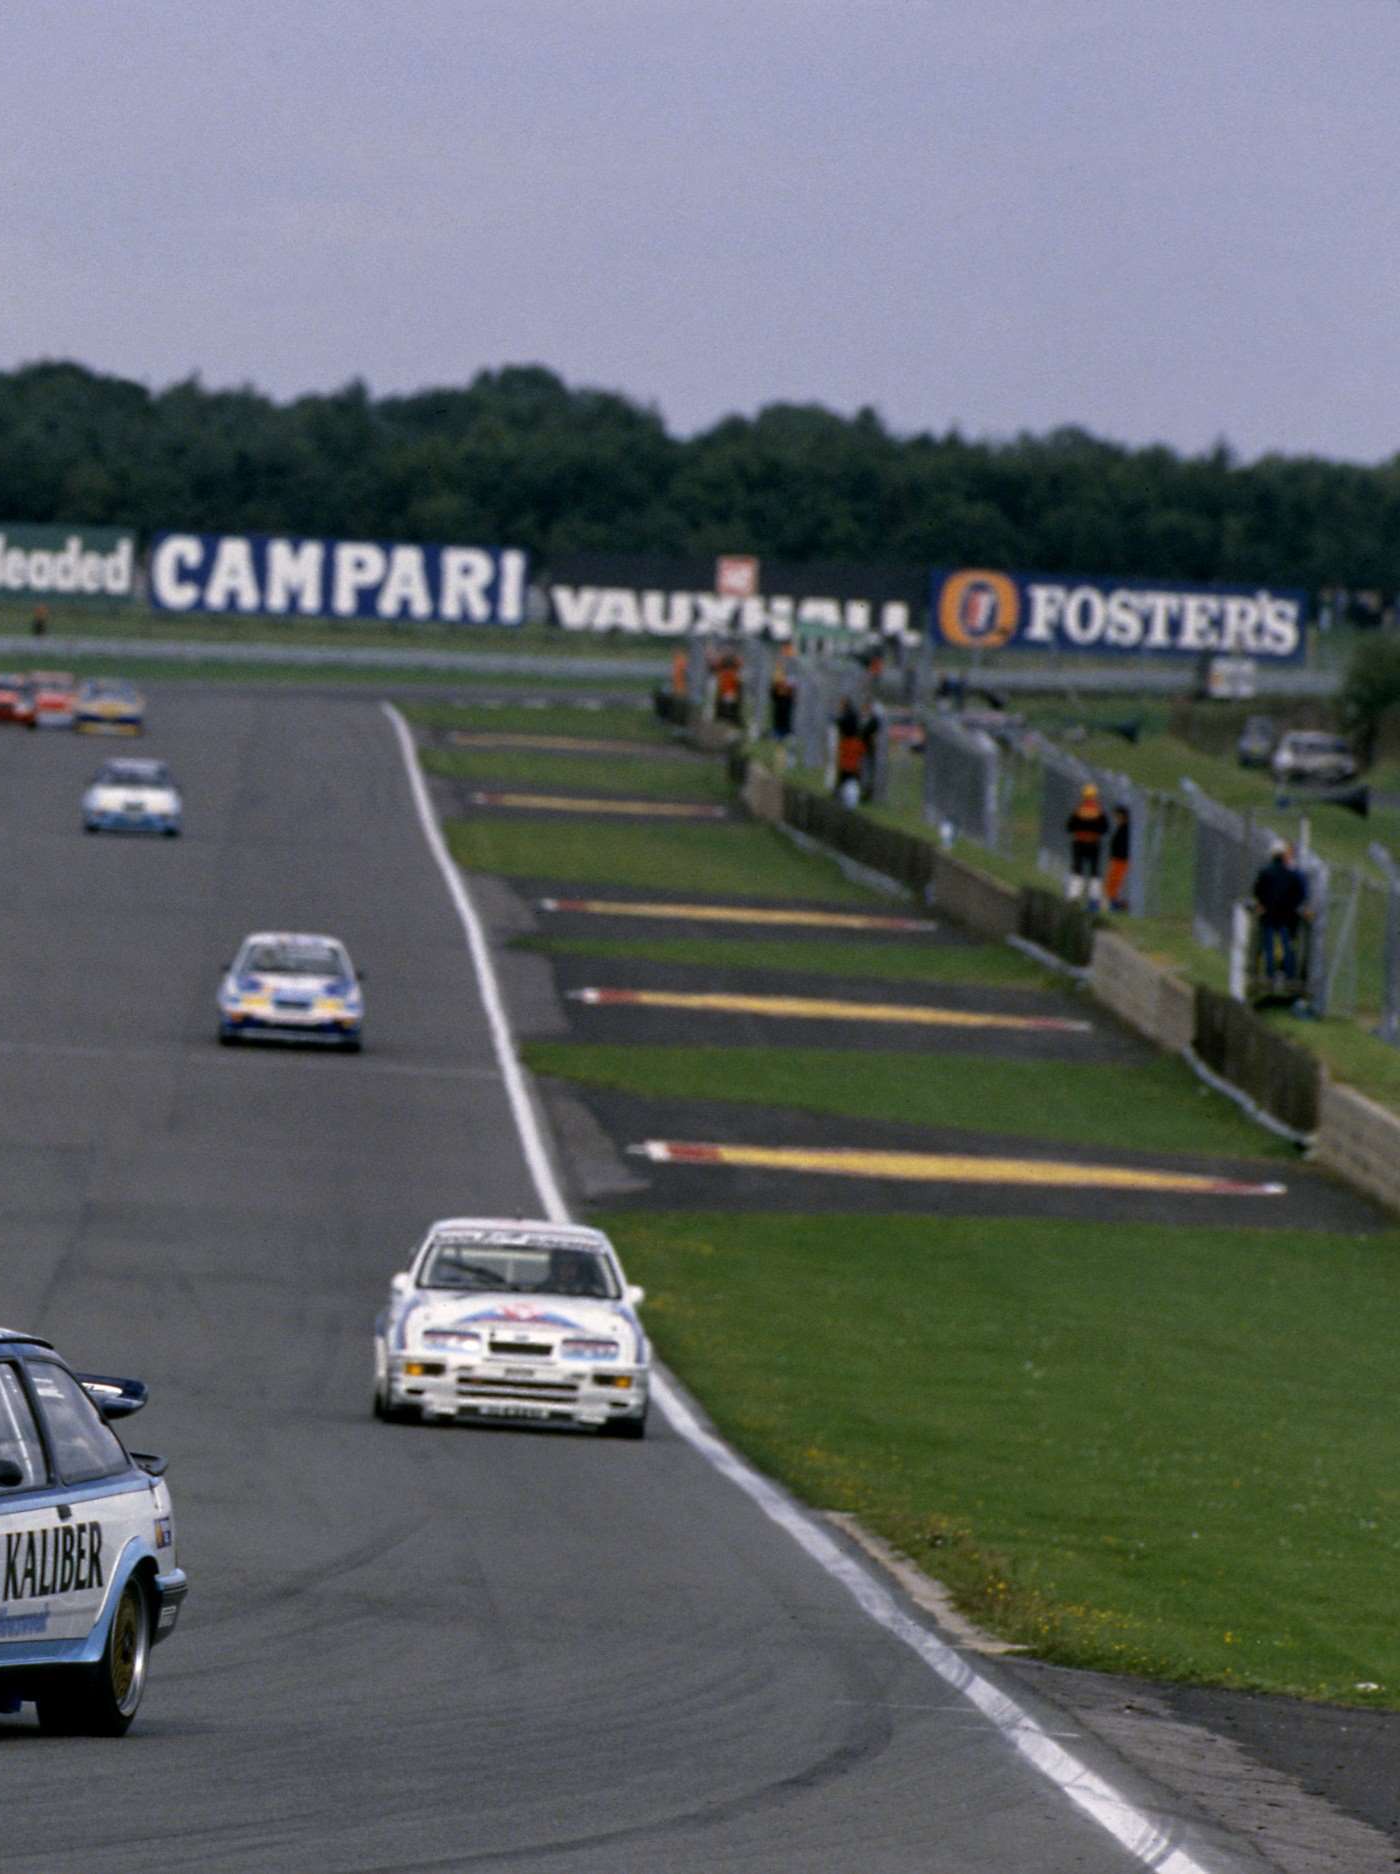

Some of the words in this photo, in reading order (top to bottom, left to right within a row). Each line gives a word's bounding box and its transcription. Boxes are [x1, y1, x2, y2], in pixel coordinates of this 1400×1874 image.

[151, 532, 527, 626] CAMPARI
[1025, 582, 1300, 657] FOSTER'S
[2, 1520, 103, 1601] KALIBER
